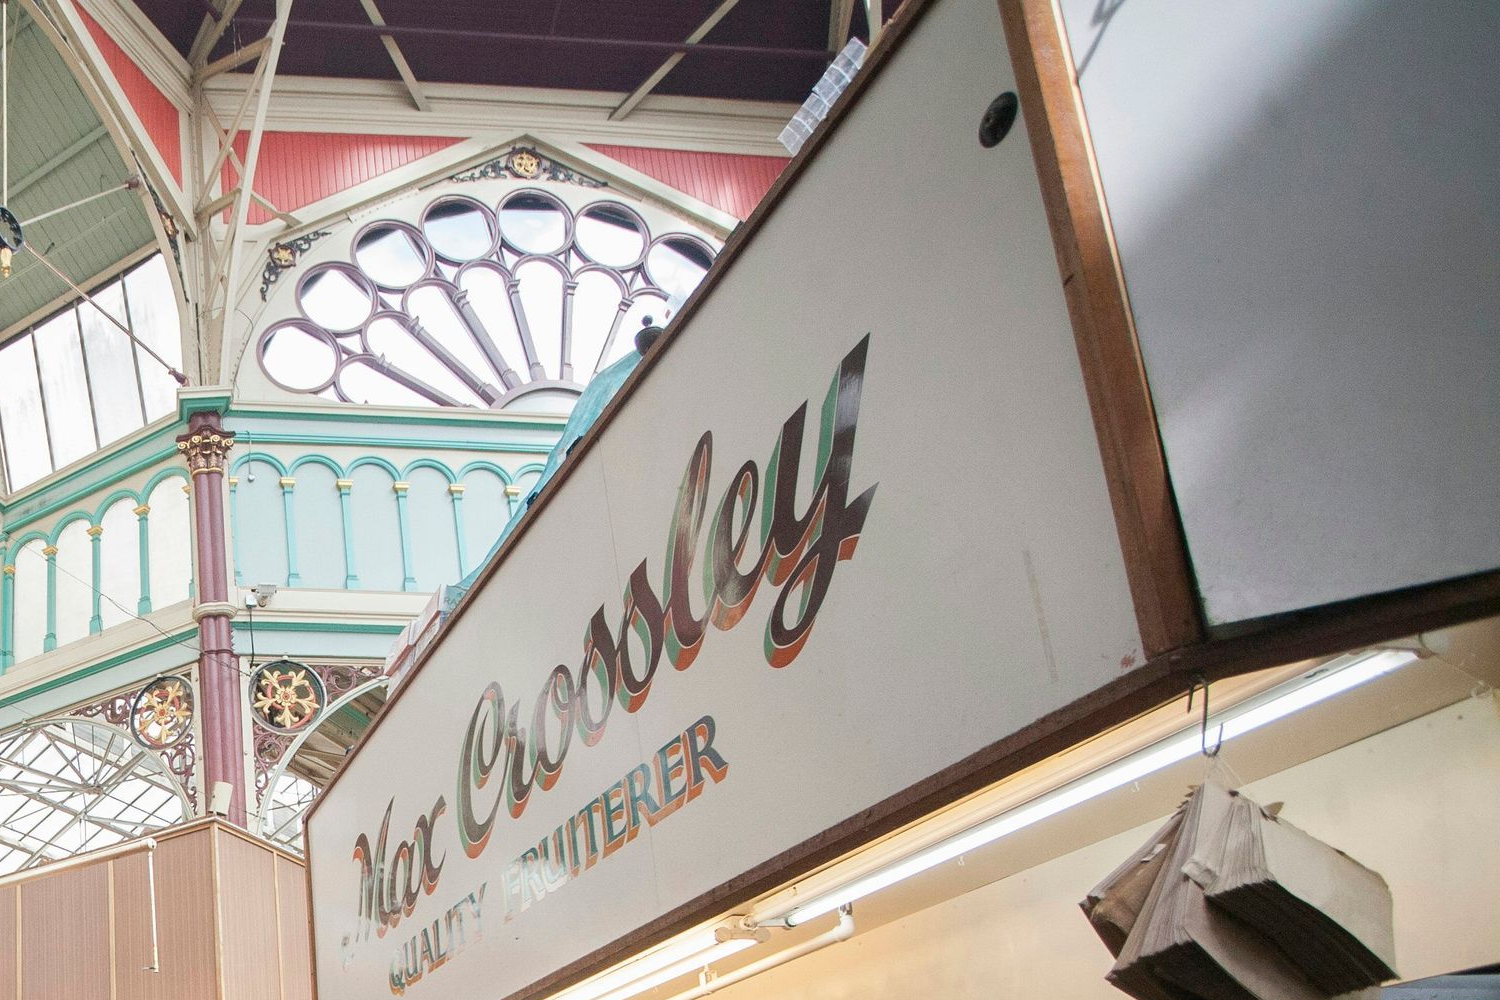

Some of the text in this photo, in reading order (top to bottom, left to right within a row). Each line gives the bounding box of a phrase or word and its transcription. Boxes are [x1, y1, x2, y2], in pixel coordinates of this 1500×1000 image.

[456, 331, 879, 859] Crossley
[388, 714, 729, 997] QUALITY FRUITERER
